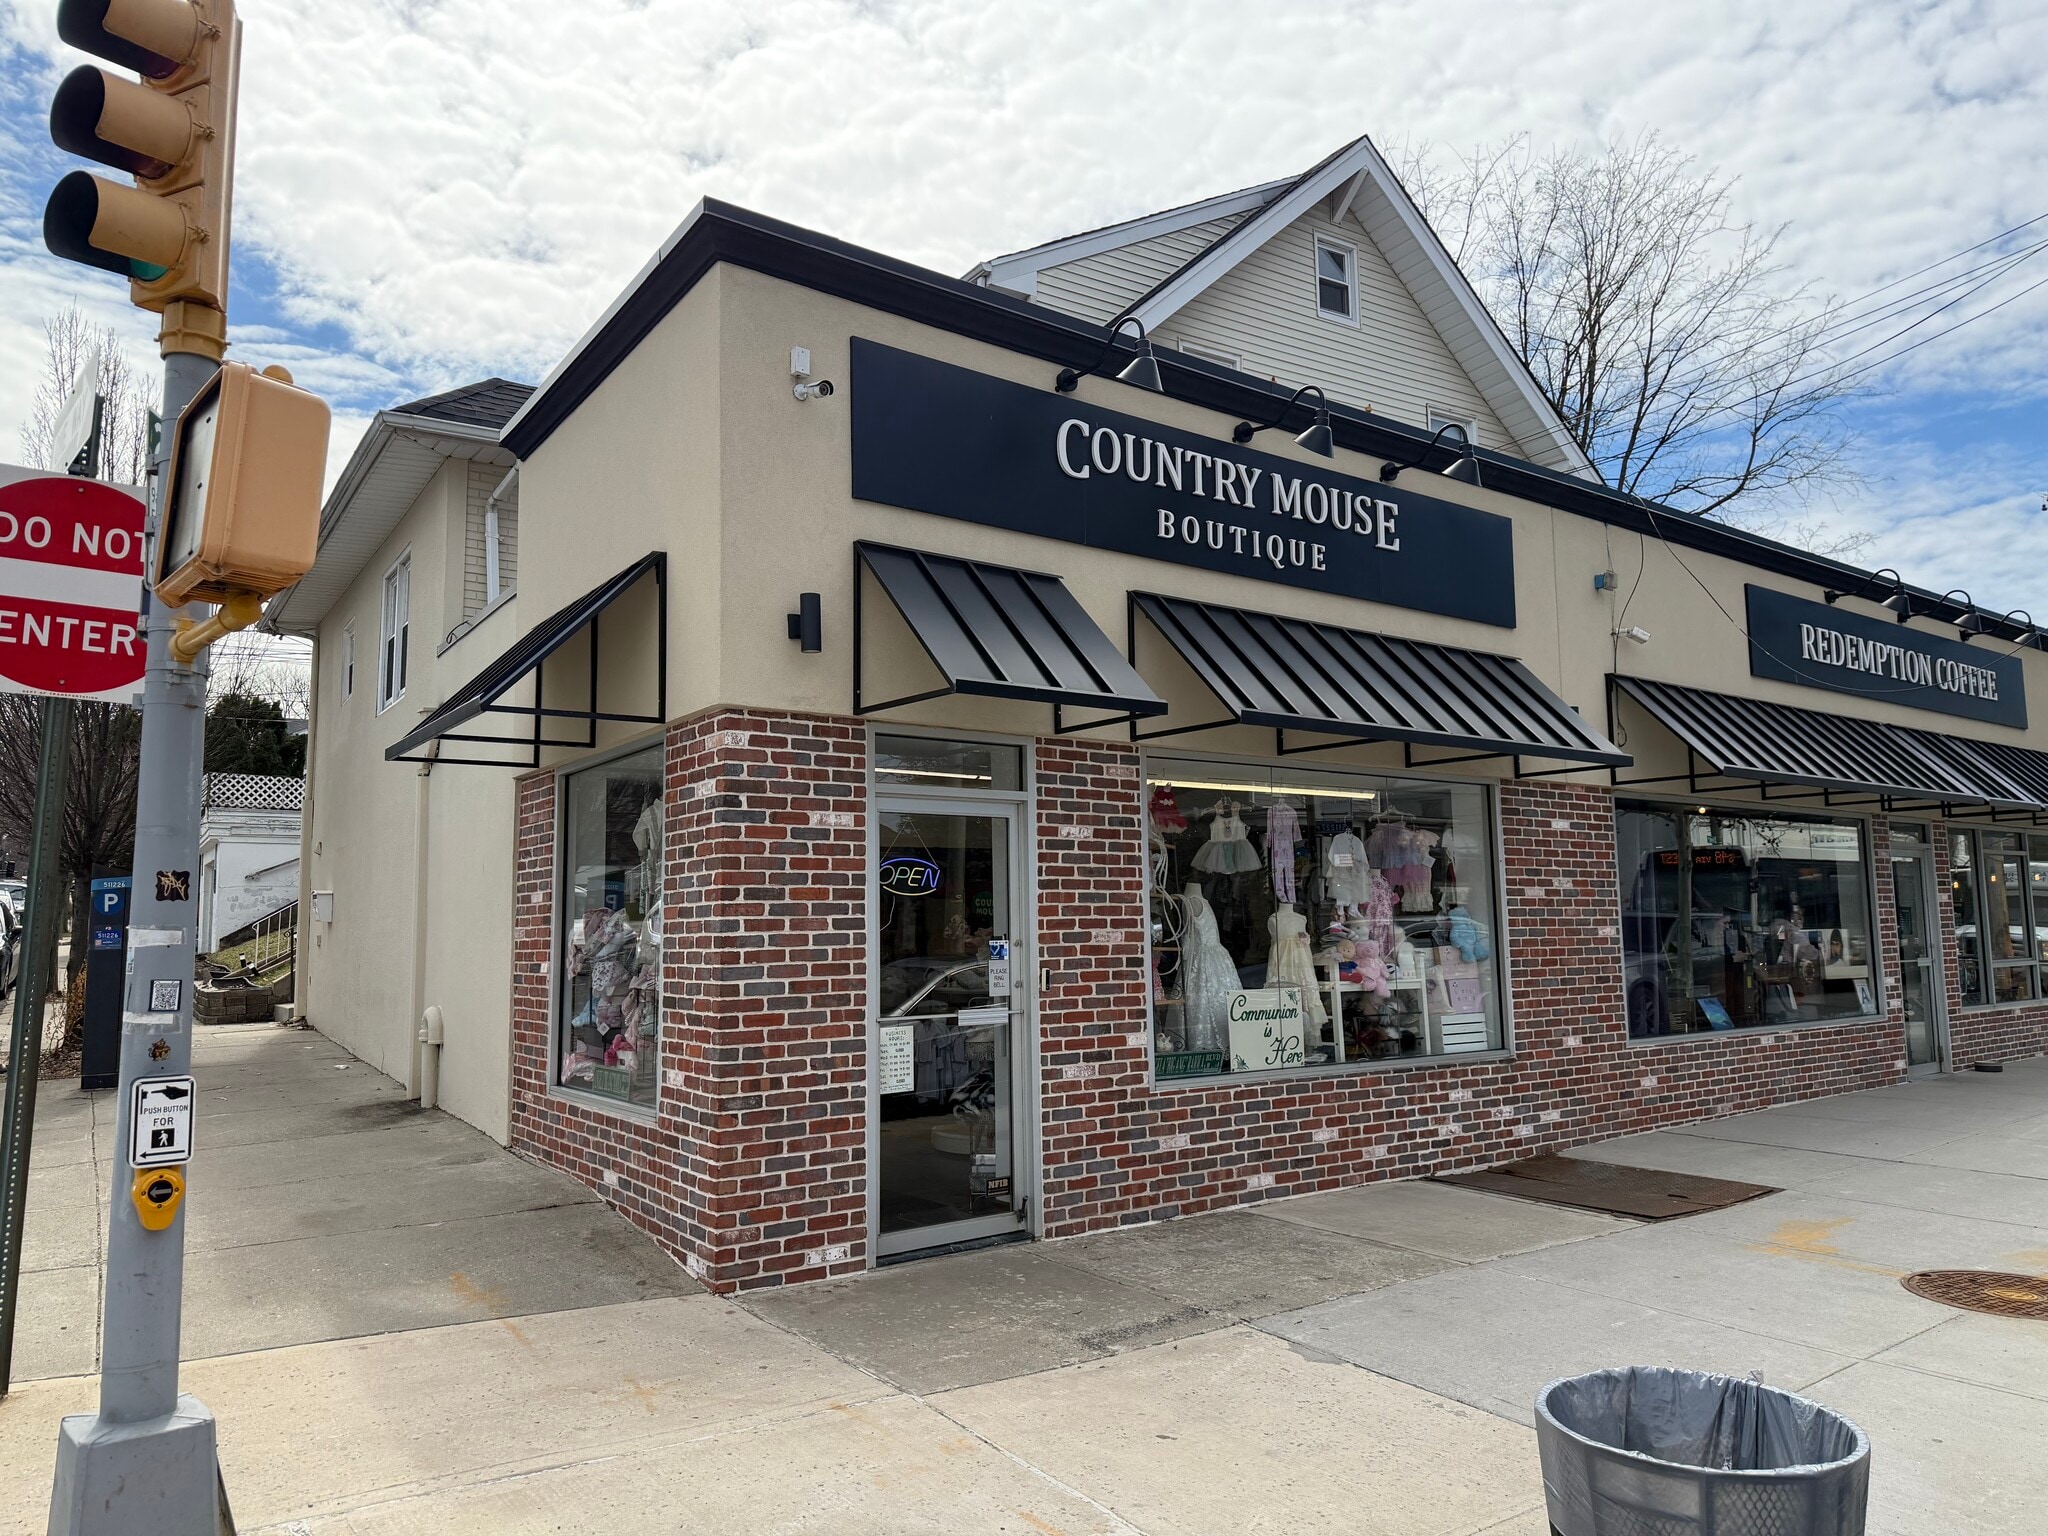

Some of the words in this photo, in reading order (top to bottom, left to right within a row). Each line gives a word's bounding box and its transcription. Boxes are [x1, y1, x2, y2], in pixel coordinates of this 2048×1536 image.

[1056, 418, 1262, 508] COUNTRY
[1271, 473, 1400, 551] MOUSE
[0, 511, 51, 548] DO
[72, 522, 146, 562] NOT
[1157, 509, 1326, 571] BOUTIQUE
[0, 610, 135, 656] ENTER
[1800, 624, 1932, 686] REDEMPTION
[1936, 658, 1998, 701] COFFEE
[880, 865, 940, 888] OPEN
[104, 893, 119, 912] P
[1230, 994, 1299, 1022] Communion
[1263, 1022, 1273, 1038] is
[1265, 1035, 1303, 1065] Here
[144, 1106, 162, 1114] PUSH
[163, 1104, 188, 1113] BUTTON
[153, 1116, 174, 1126] FOR
[988, 1178, 1009, 1188] NFIB
